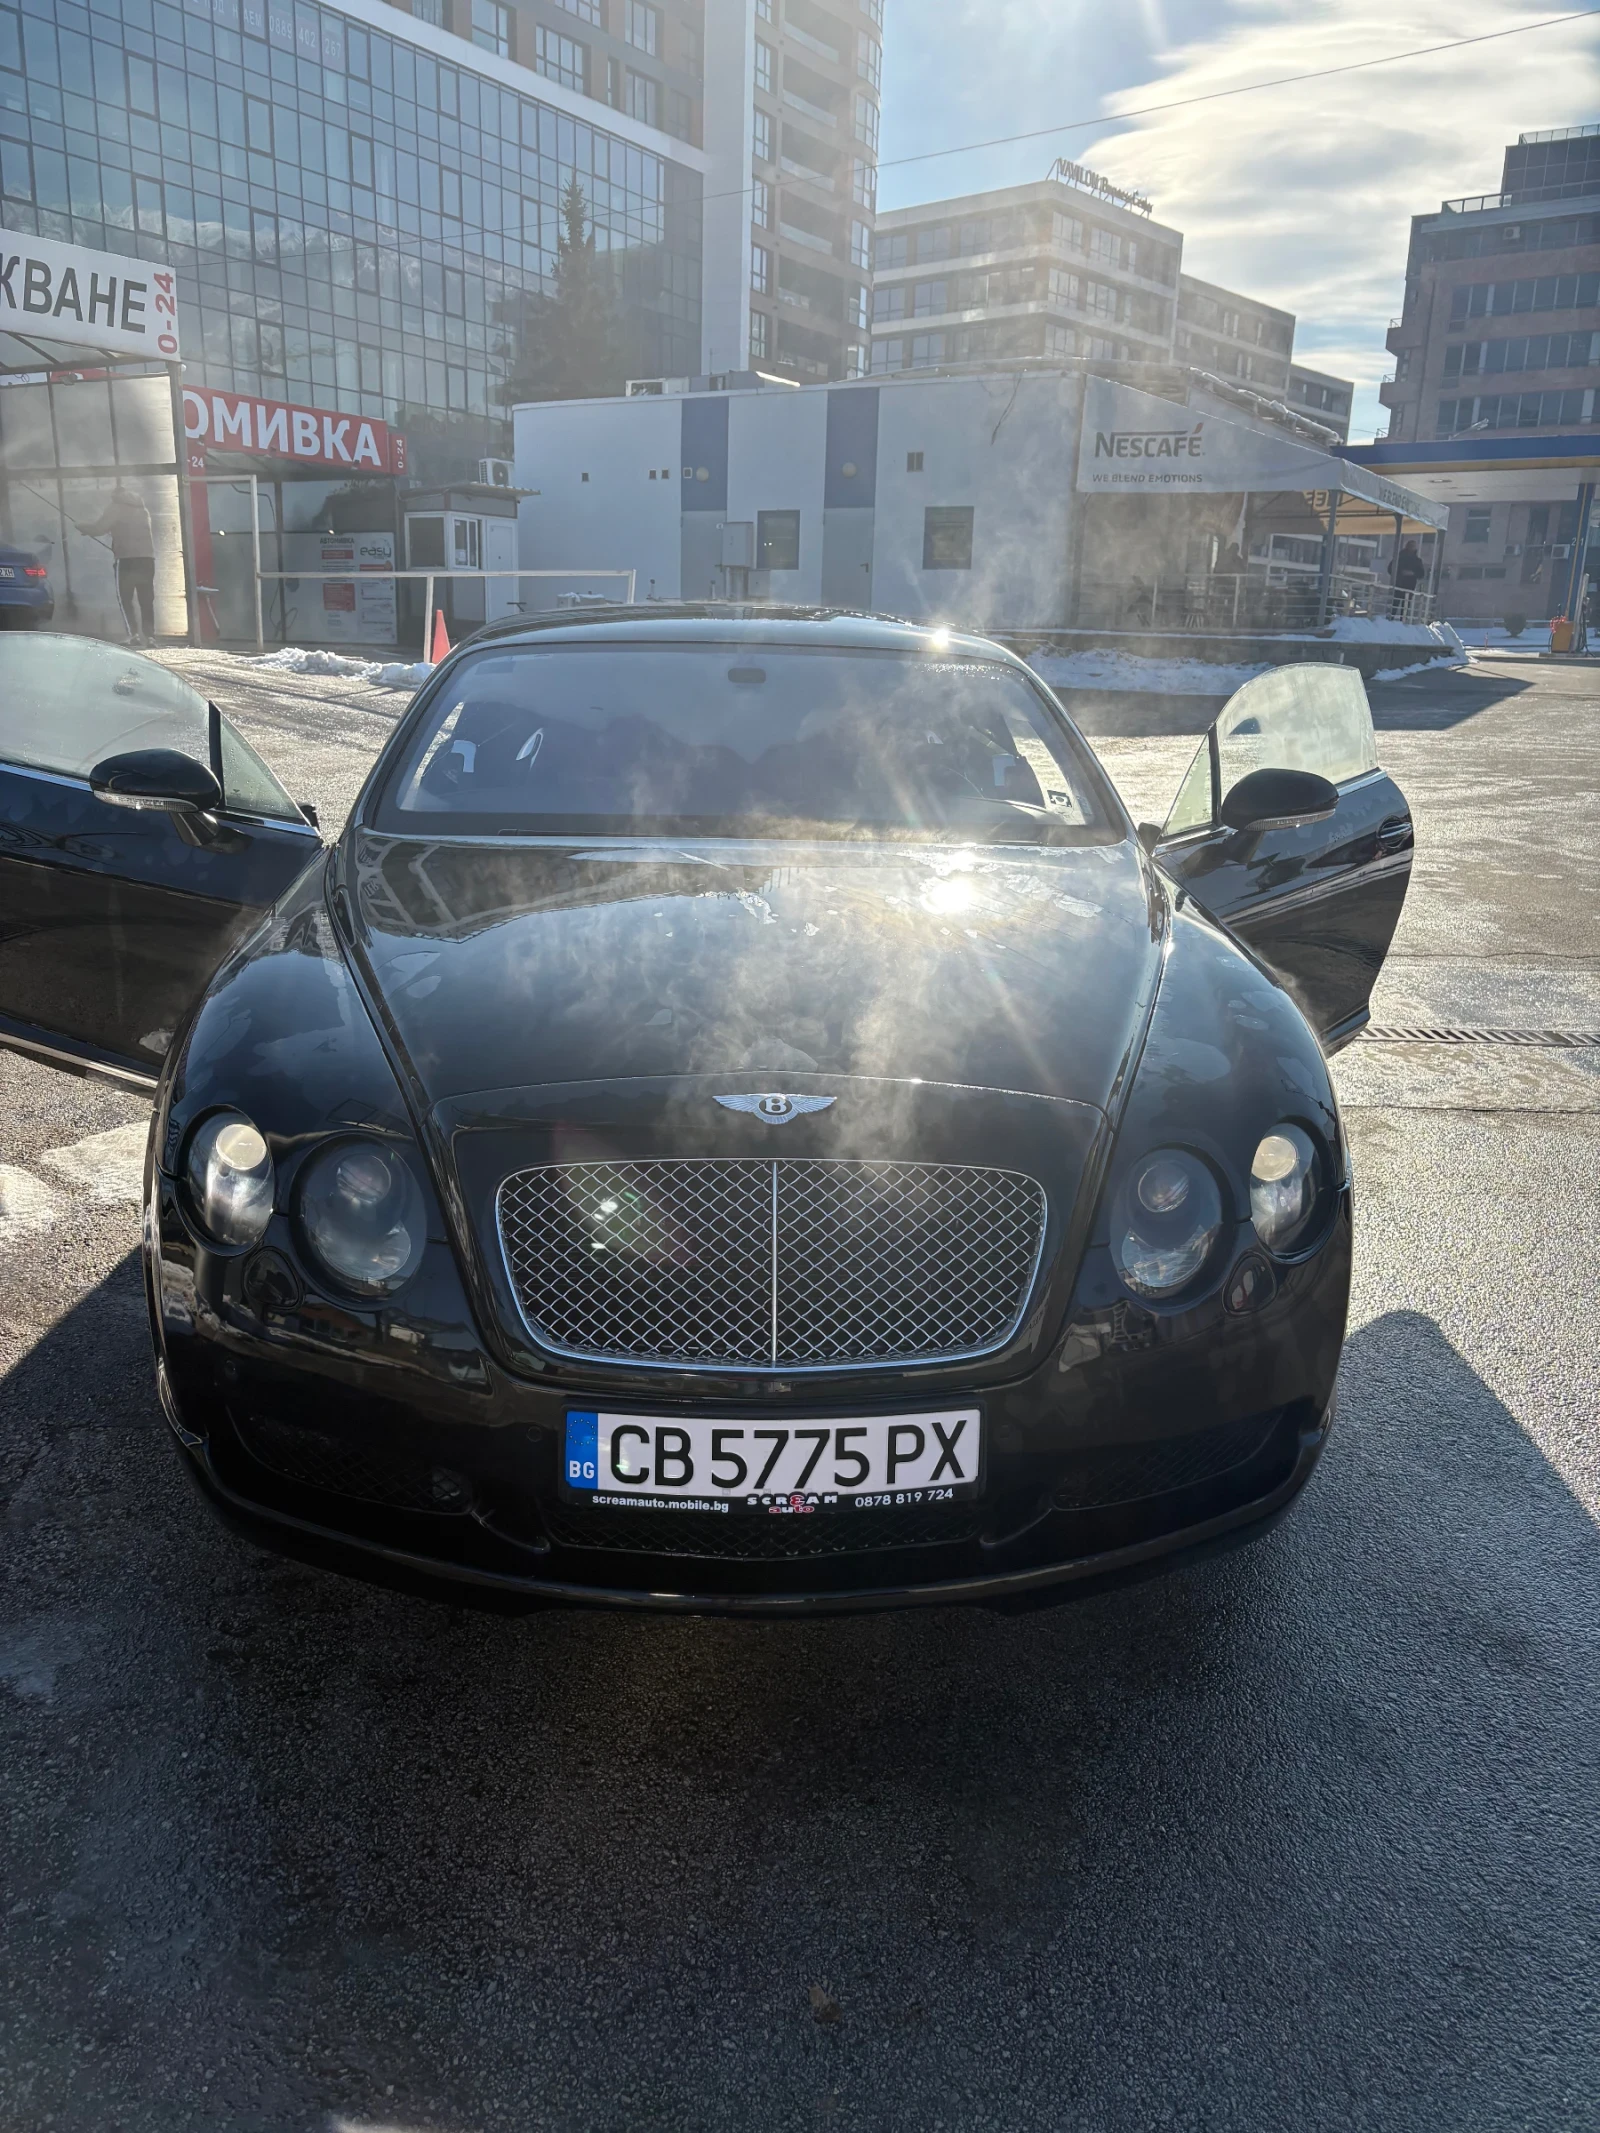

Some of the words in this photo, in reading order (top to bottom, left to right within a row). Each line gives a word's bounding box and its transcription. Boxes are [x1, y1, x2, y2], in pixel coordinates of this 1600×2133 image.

[269, 16, 293, 39] 0889
[299, 28, 316, 48] 402
[325, 38, 342, 58] 267
[0, 252, 148, 334] КВАНЕ
[153, 272, 178, 354] 0-24
[183, 390, 381, 466] ОМИВКА
[1095, 422, 1204, 458] NESCAFÉ
[396, 439, 404, 469] 0-24
[1092, 474, 1109, 483] WE
[1111, 474, 1145, 483] BLEND
[1148, 474, 1203, 483] EMOTIONS
[360, 546, 392, 558] easy
[611, 1424, 694, 1486] CB
[711, 1426, 870, 1490] 5775
[886, 1419, 967, 1485] PX
[569, 1460, 595, 1479] BG
[592, 1494, 729, 1513] screamauto.mobile.bg
[747, 1494, 838, 1506] SCREAM
[768, 1505, 815, 1514] auto
[855, 1494, 891, 1508] 0878
[895, 1491, 923, 1505] 819
[927, 1487, 954, 1501] 724
